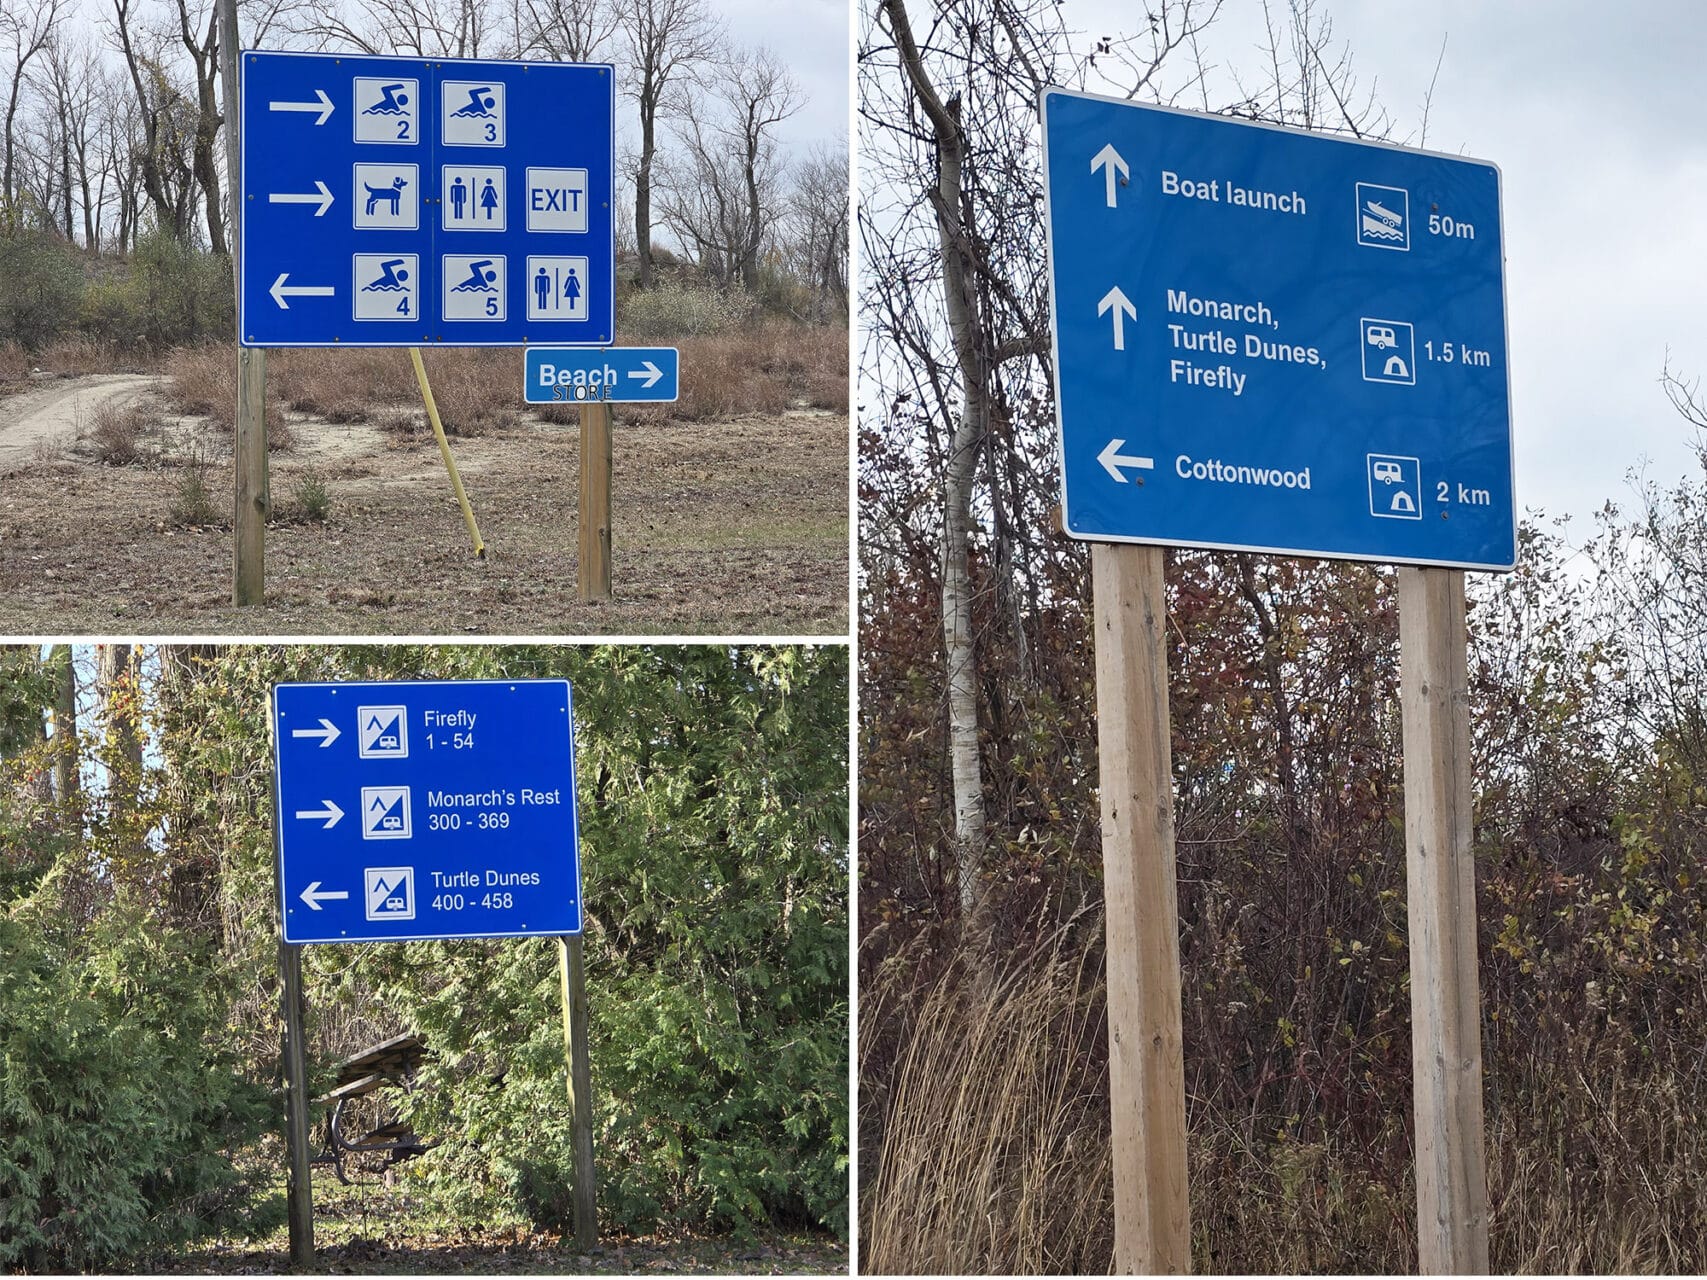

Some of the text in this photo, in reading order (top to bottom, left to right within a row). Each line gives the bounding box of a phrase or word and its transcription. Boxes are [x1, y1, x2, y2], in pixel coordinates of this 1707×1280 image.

[397, 121, 409, 139] 2
[485, 124, 496, 141] 3
[532, 189, 583, 211] EXIT
[1162, 171, 1306, 214] Boat launch
[1428, 214, 1475, 239] 50m
[397, 297, 410, 316] 4
[486, 298, 498, 316] 5
[1168, 290, 1279, 330] Monarch,
[1169, 325, 1327, 369] Turtle Dunes,
[1425, 341, 1491, 366] 1.5 km
[540, 363, 617, 386] Beach
[1171, 360, 1246, 396] Firefly
[552, 385, 612, 401] STORE
[1176, 455, 1311, 489] Cottonwood
[1437, 483, 1490, 505] 2 km
[425, 710, 476, 729] Firefly
[426, 735, 433, 749] 1
[454, 734, 474, 749] 54
[428, 789, 560, 807] Monarch's Rest
[429, 814, 461, 830] 300
[478, 813, 509, 828] 369
[432, 870, 540, 888] Turtle Dunes
[432, 895, 464, 911] 400
[482, 894, 513, 909] 458
